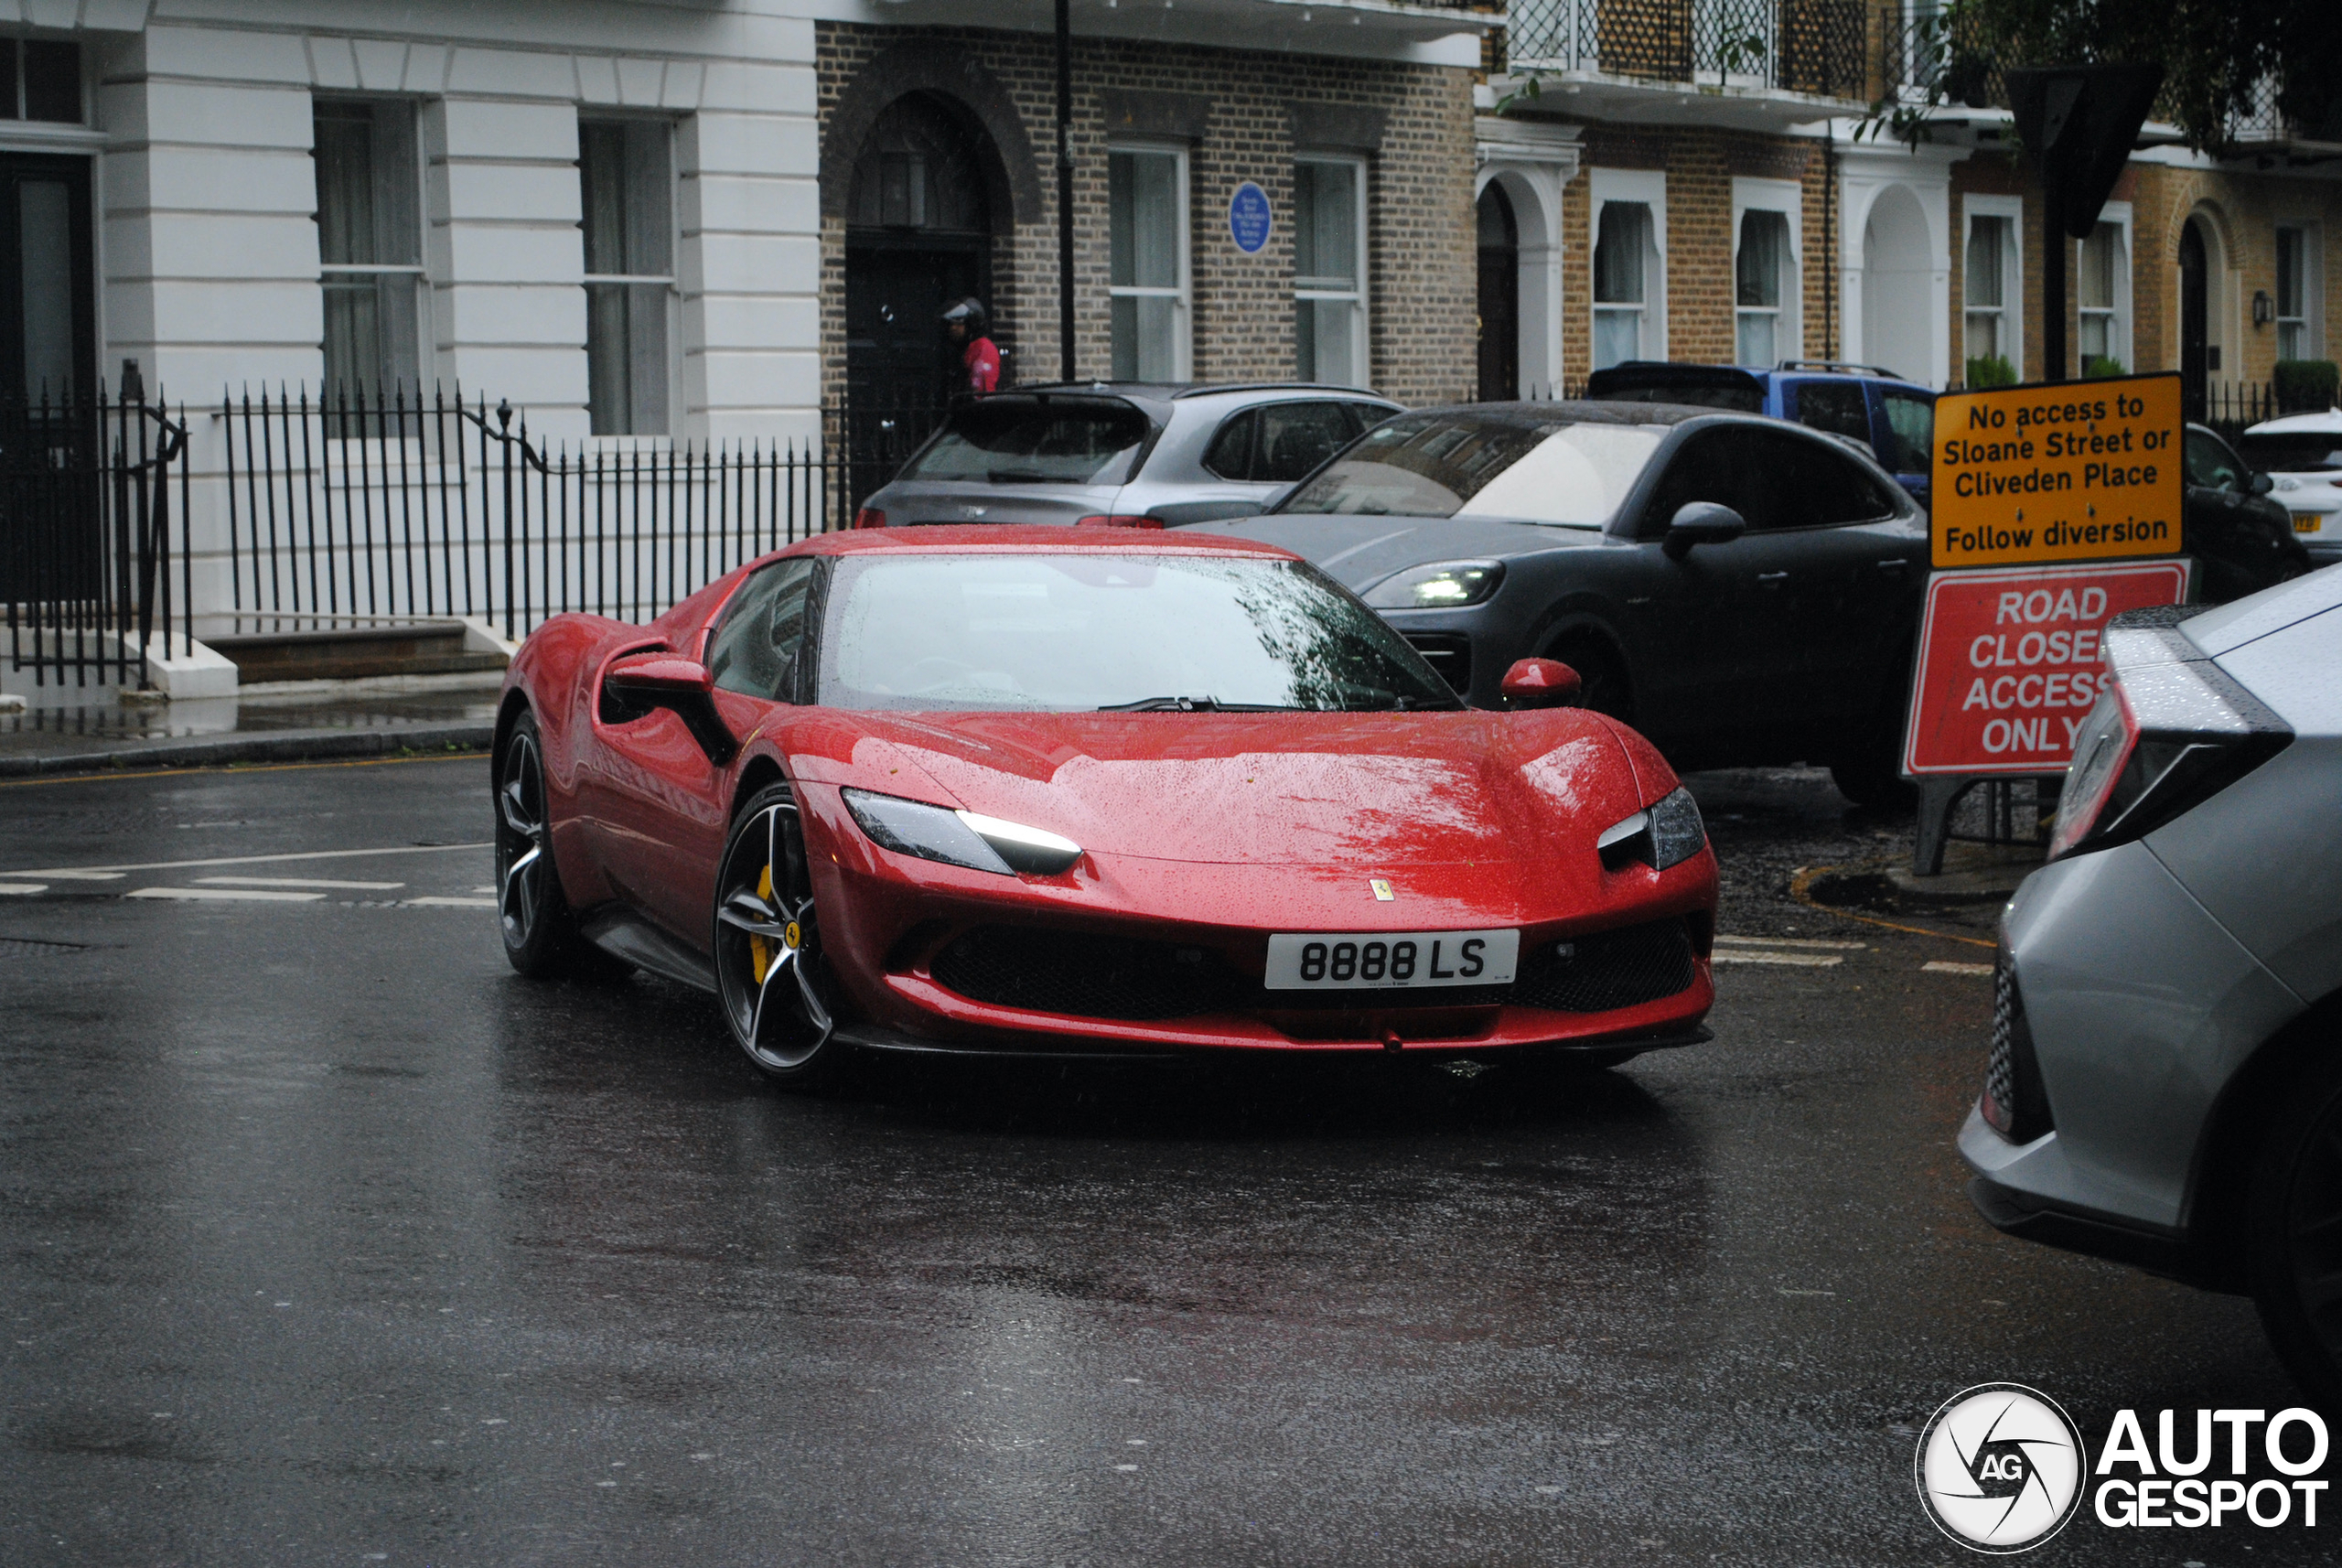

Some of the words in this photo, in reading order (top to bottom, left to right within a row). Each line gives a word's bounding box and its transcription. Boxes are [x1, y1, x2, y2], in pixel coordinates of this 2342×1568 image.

[1969, 404, 2005, 430] No
[2017, 400, 2106, 426] access
[2117, 393, 2144, 418] to
[1943, 439, 2034, 465] Sloane
[2046, 432, 2133, 457] Street
[2143, 428, 2171, 449] or
[1955, 470, 2072, 497] Cliveden
[2085, 464, 2158, 489] Place
[1946, 526, 2033, 552] Follow
[2044, 516, 2168, 546] diversion
[1996, 587, 2107, 624] ROAD
[1982, 718, 2086, 753] ONLY
[1300, 941, 1417, 981] 8888
[1429, 939, 1486, 979] LS
